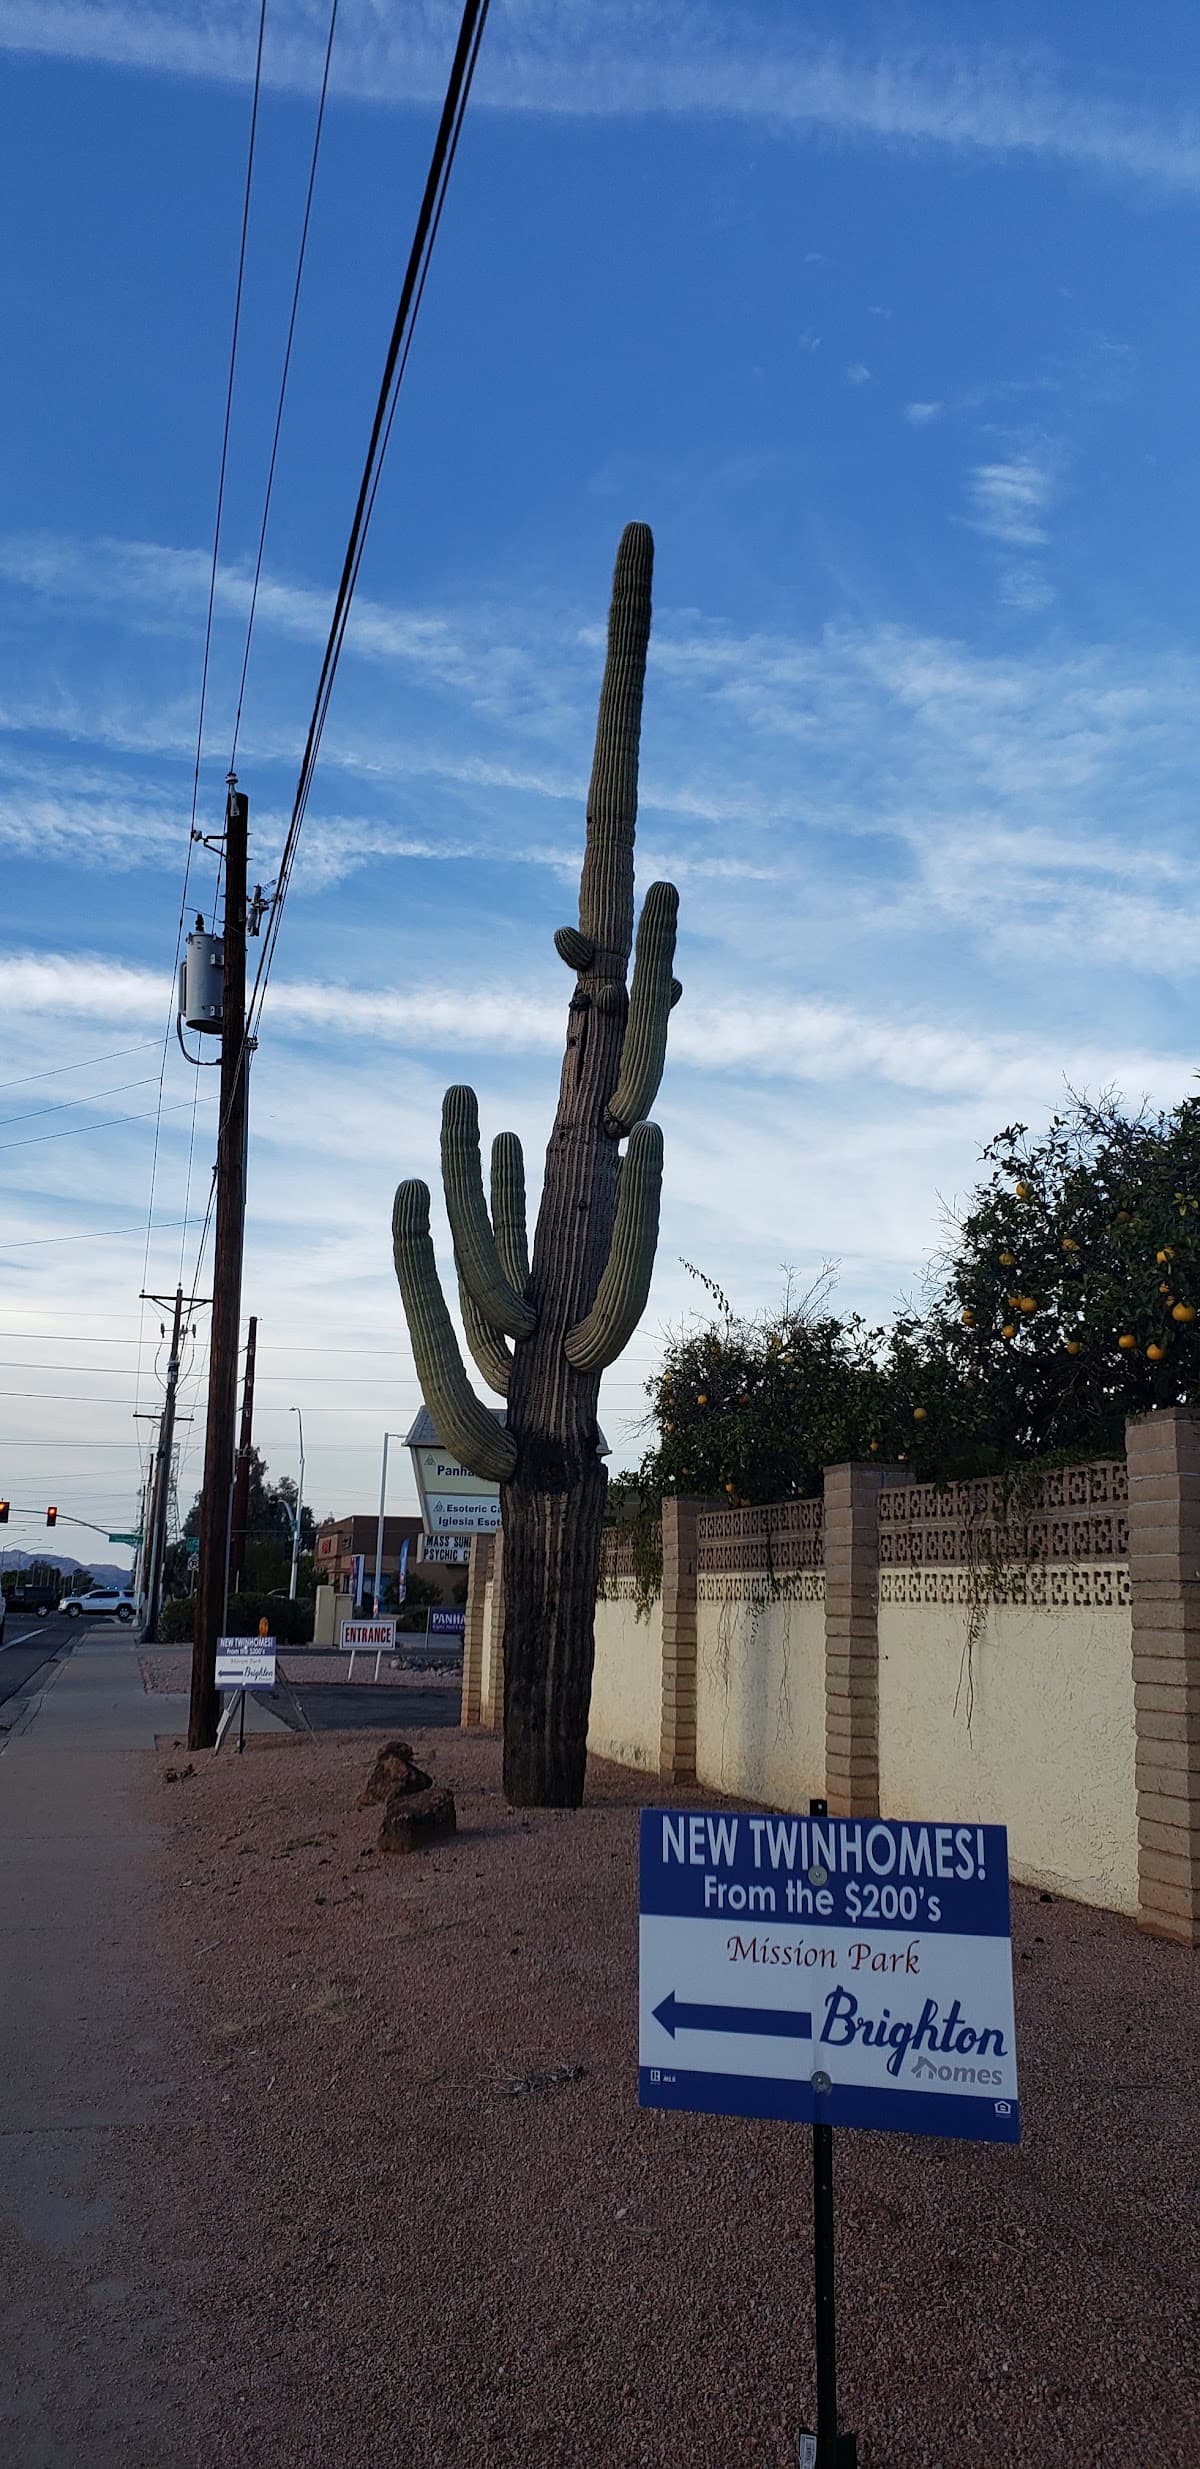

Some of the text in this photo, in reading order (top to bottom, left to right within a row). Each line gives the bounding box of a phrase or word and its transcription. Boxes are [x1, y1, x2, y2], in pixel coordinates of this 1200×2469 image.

[447, 1504, 487, 1513] Esoteric
[439, 1517, 474, 1527] Iglesia
[426, 1536, 449, 1547] MASS
[424, 1549, 458, 1560] PSYCHIC
[345, 1627, 391, 1643] ENTRANCE
[661, 1814, 986, 1882] NEW TWINHOMES!
[704, 1875, 942, 1922] From the $200's
[727, 1935, 921, 1975] Mission Park
[819, 1984, 1009, 2077] Brighton
